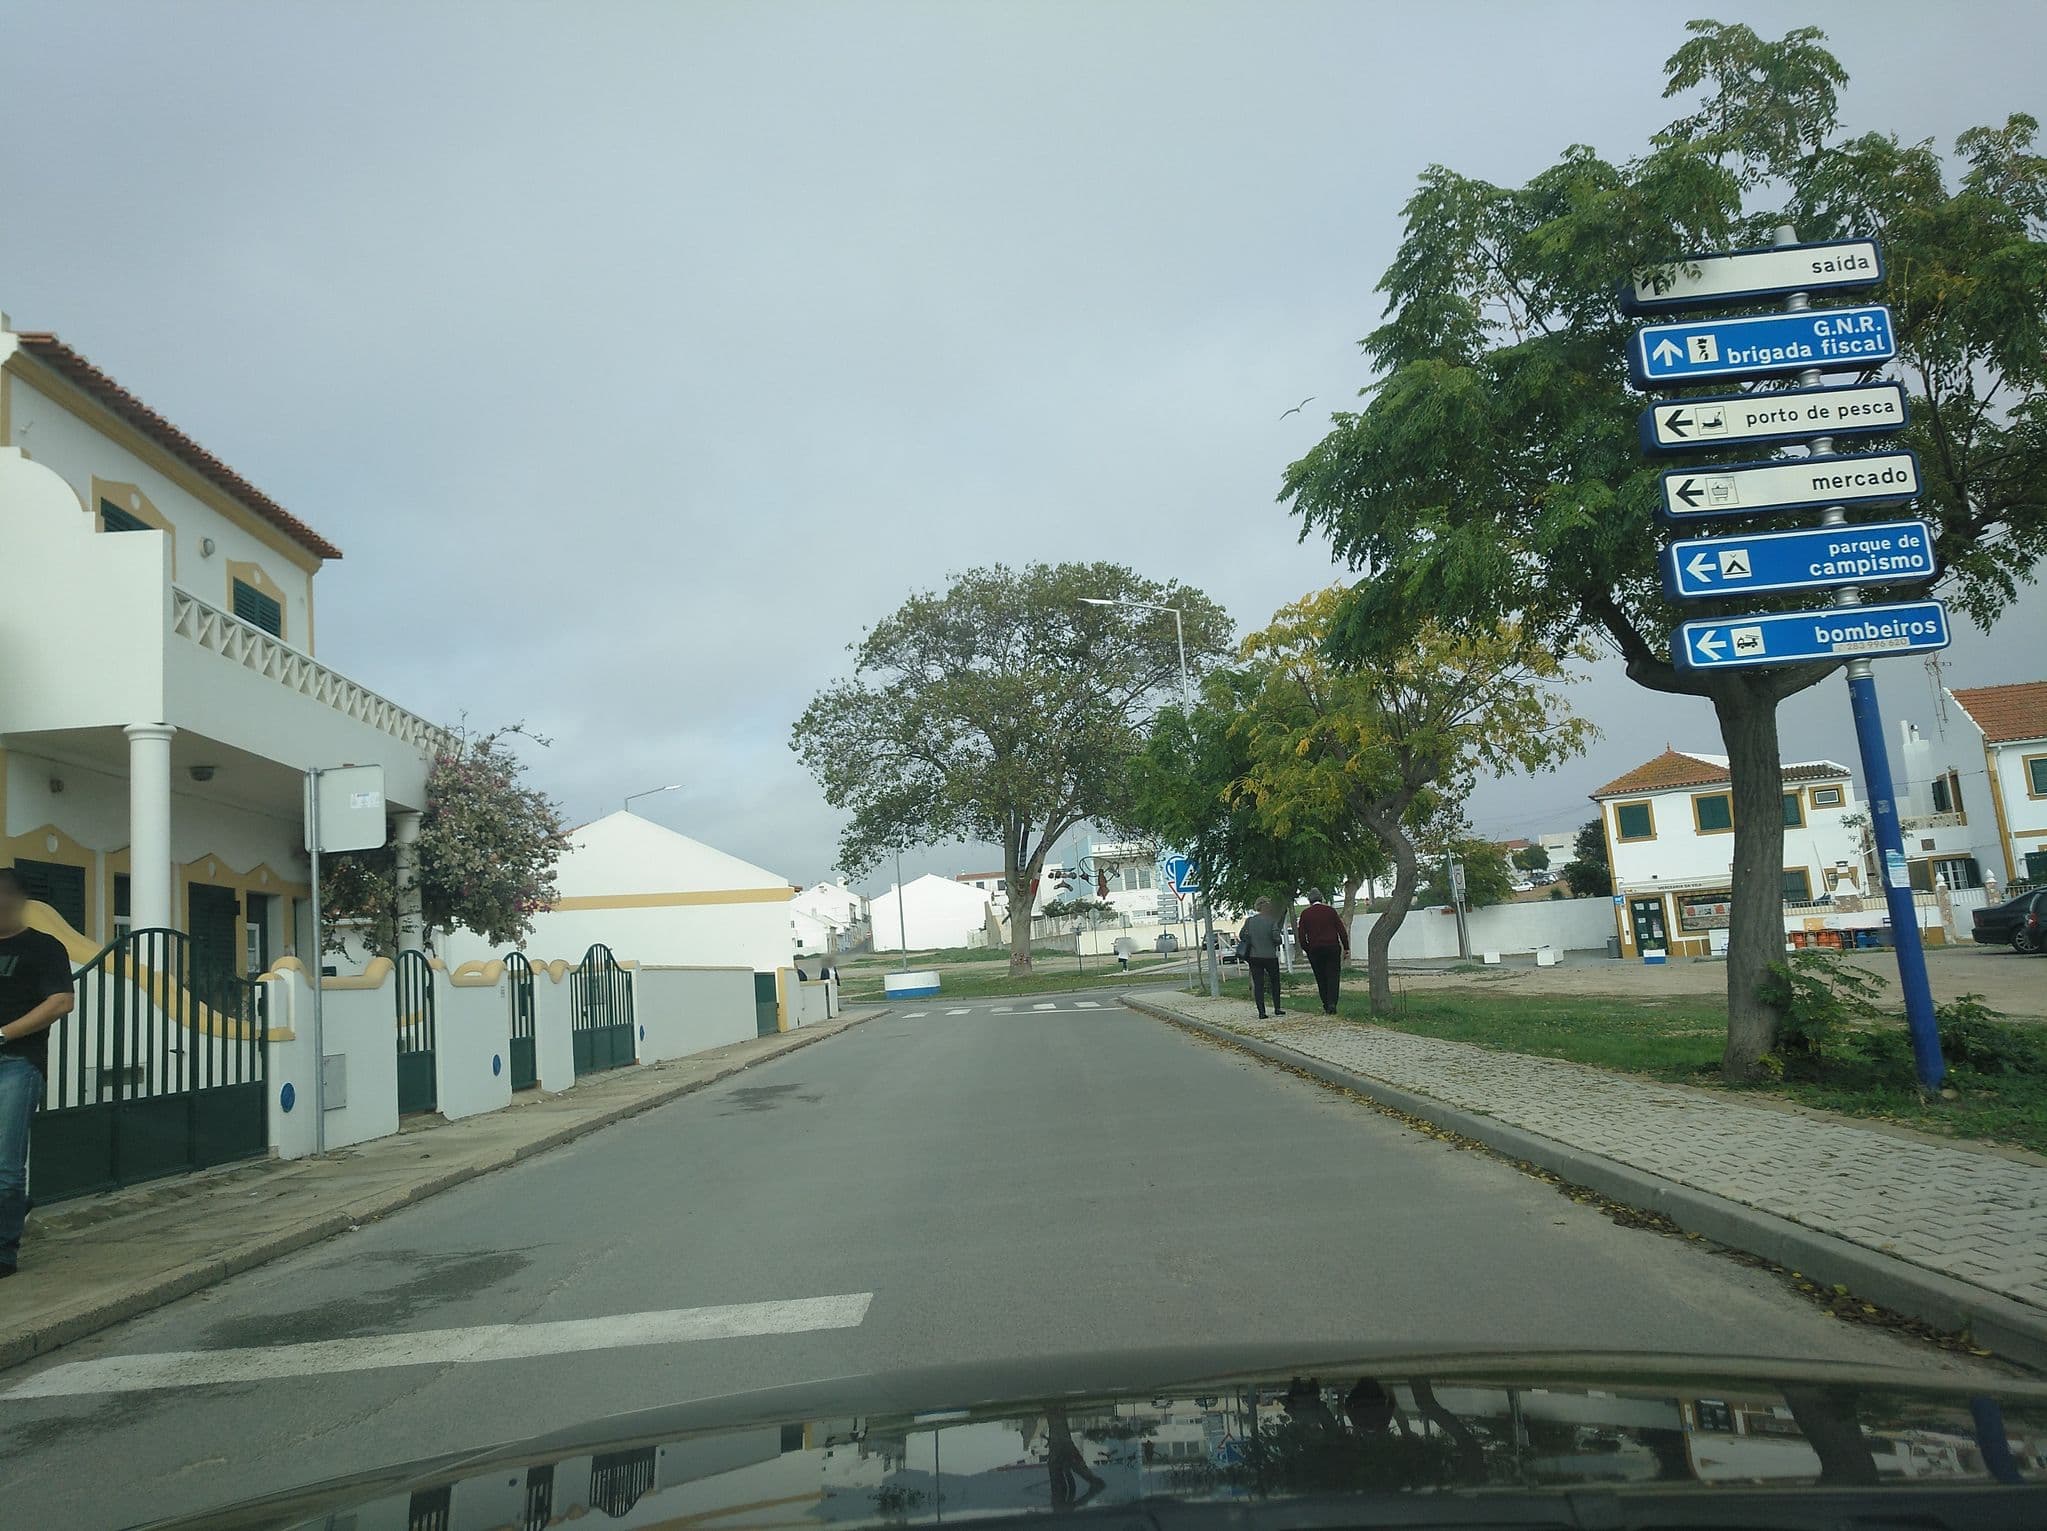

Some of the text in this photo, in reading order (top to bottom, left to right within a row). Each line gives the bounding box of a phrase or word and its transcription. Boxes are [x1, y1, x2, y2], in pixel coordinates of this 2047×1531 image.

[1811, 254, 1870, 274] saída
[1813, 315, 1882, 337] G.N.R.
[1727, 333, 1886, 364] brigada fiscal
[1745, 401, 1895, 428] porto de pesca
[1811, 467, 1908, 491] mercado
[1828, 534, 1921, 557] parque de
[1809, 555, 1924, 576] campismo
[1815, 619, 1937, 643] bombeiros
